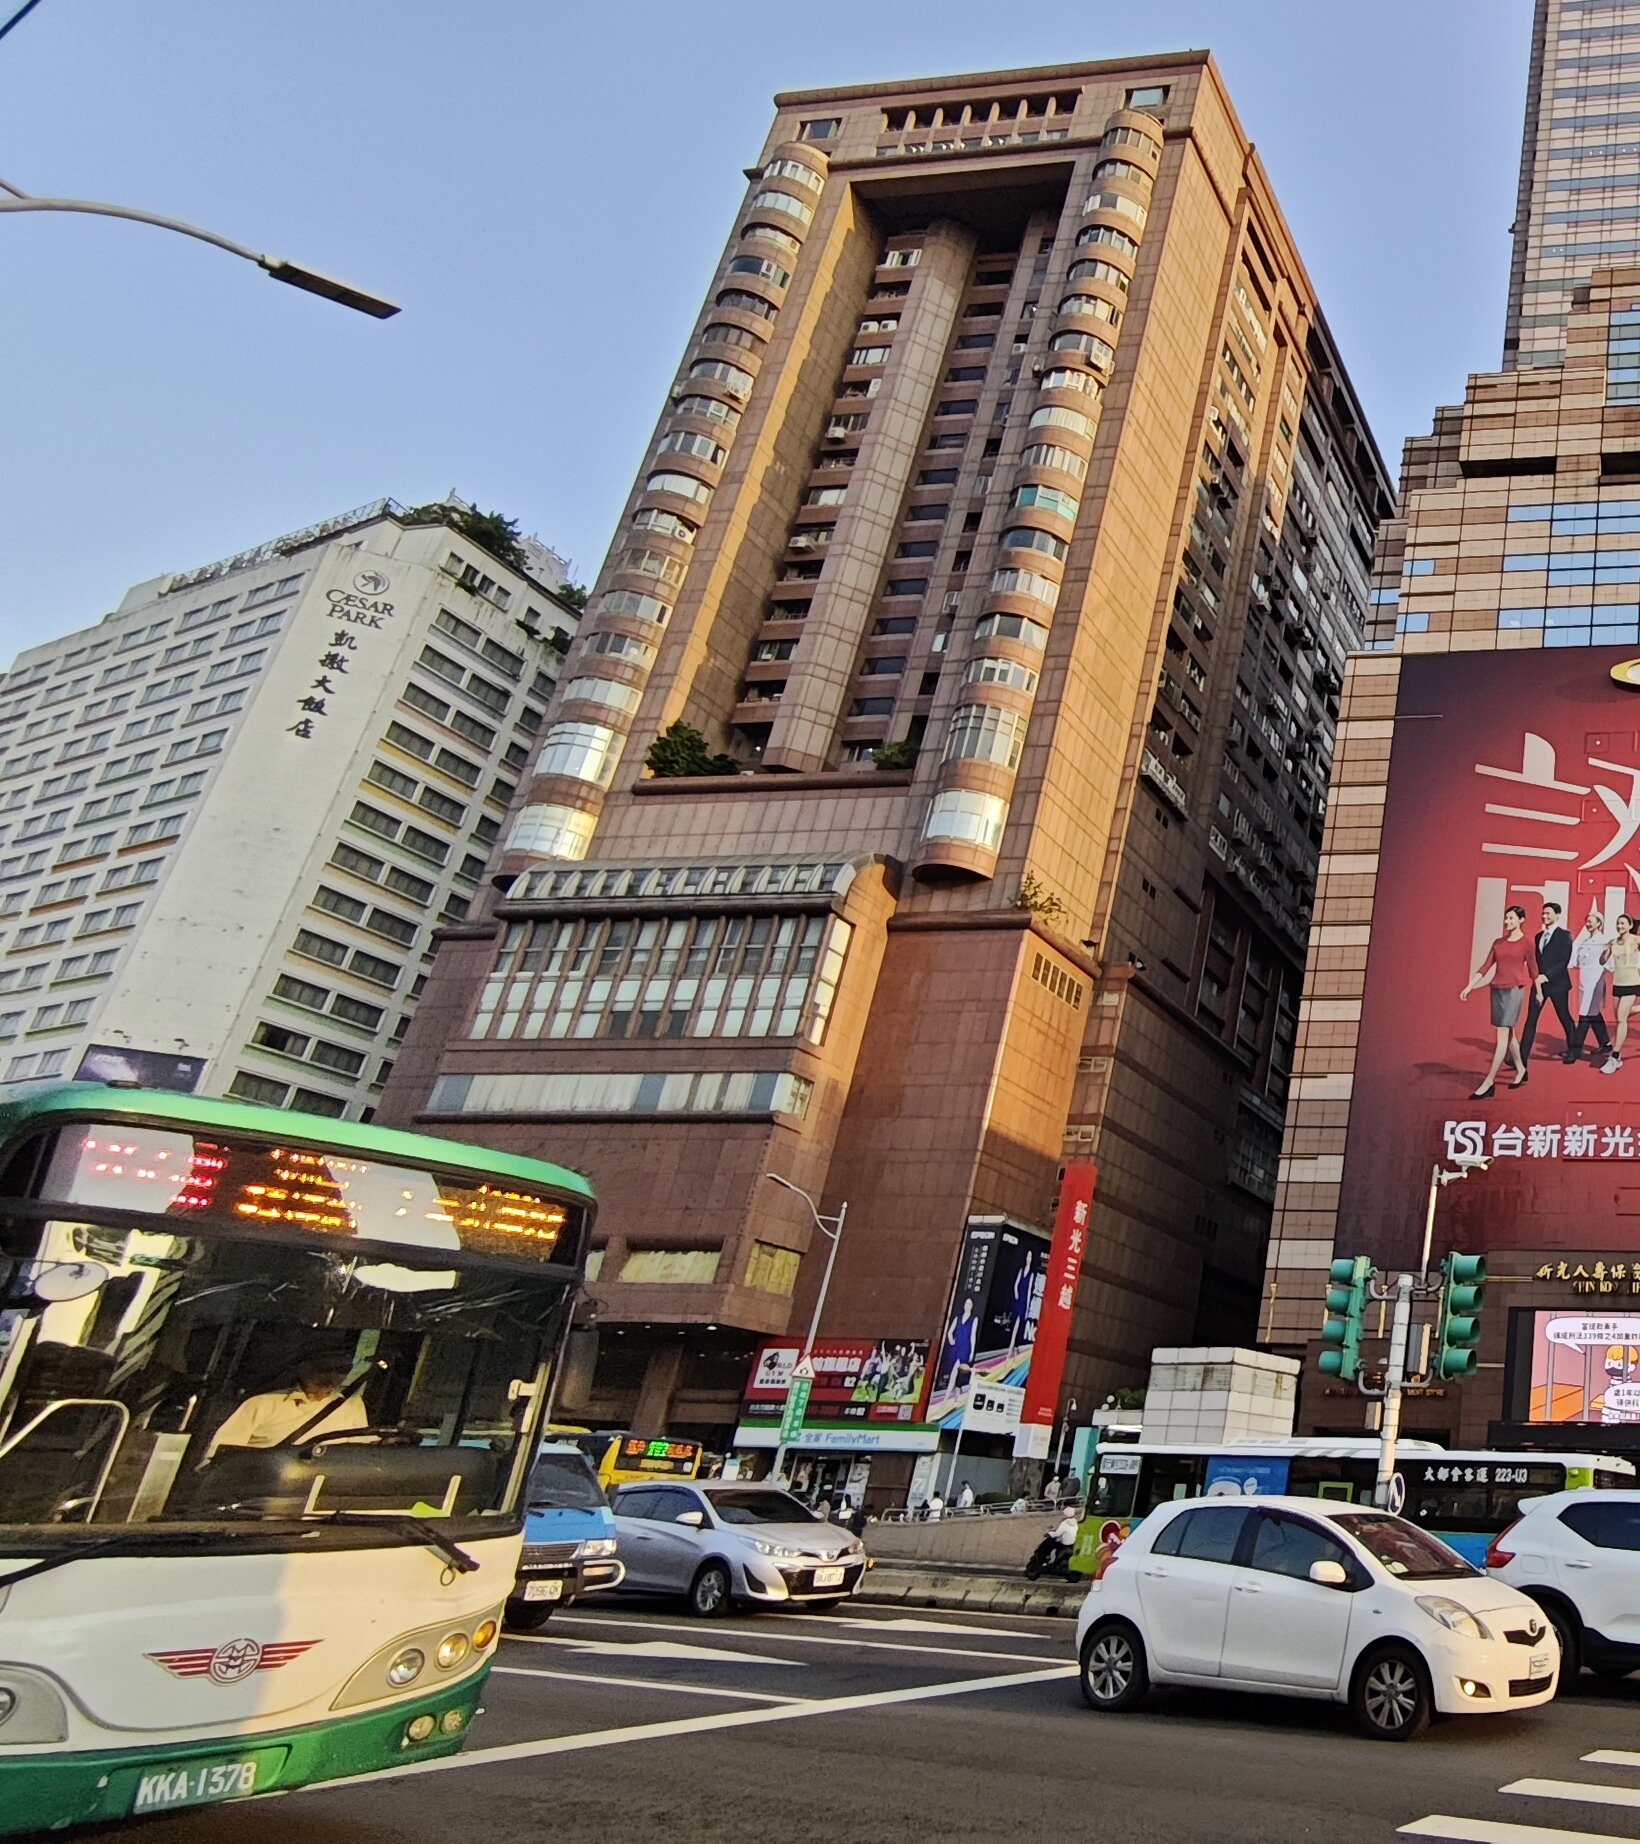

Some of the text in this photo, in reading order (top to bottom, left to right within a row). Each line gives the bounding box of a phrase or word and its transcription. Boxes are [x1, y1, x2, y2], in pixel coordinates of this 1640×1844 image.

[326, 603, 385, 630] PARK
[286, 629, 358, 739] 凱撒大飯店
[1057, 1199, 1089, 1310] 新光三越
[825, 1433, 880, 1445] FamilyMart
[135, 1762, 257, 1806] KKA-1378
